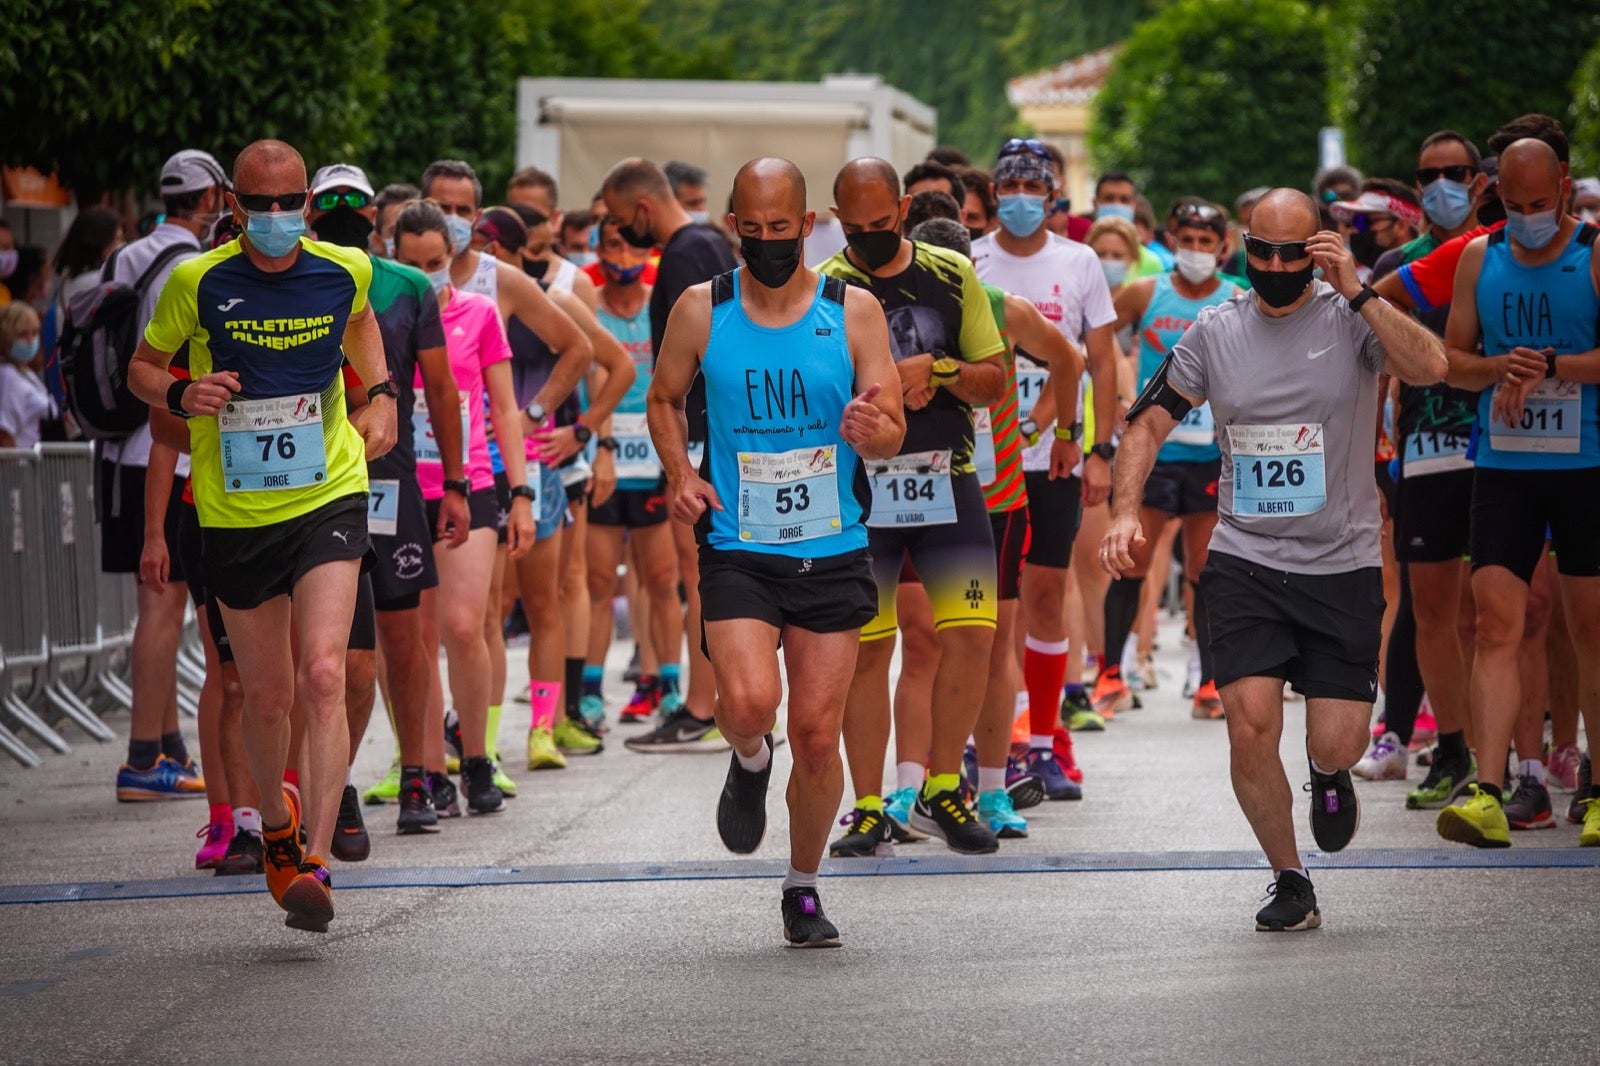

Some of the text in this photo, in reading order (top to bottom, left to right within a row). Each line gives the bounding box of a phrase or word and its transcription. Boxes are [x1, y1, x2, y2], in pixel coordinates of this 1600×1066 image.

[224, 314, 335, 333] ATLETISMO
[1502, 292, 1553, 337] ENA
[232, 325, 330, 350] ALHENDÍN
[745, 368, 809, 421] ENA
[733, 424, 795, 435] entrenamiento
[798, 425, 805, 437] y
[1510, 408, 1564, 431] 011
[255, 432, 296, 462] 76
[613, 442, 649, 460] 100
[1412, 432, 1468, 456] 114
[225, 445, 233, 468] MASTER
[263, 474, 290, 487] JORGE
[1252, 459, 1305, 488] 126
[775, 483, 810, 515] 53
[886, 478, 935, 501] 184
[896, 512, 925, 524] ALVARO
[1257, 501, 1295, 513] ALBERTO
[778, 525, 804, 540] JORGE
